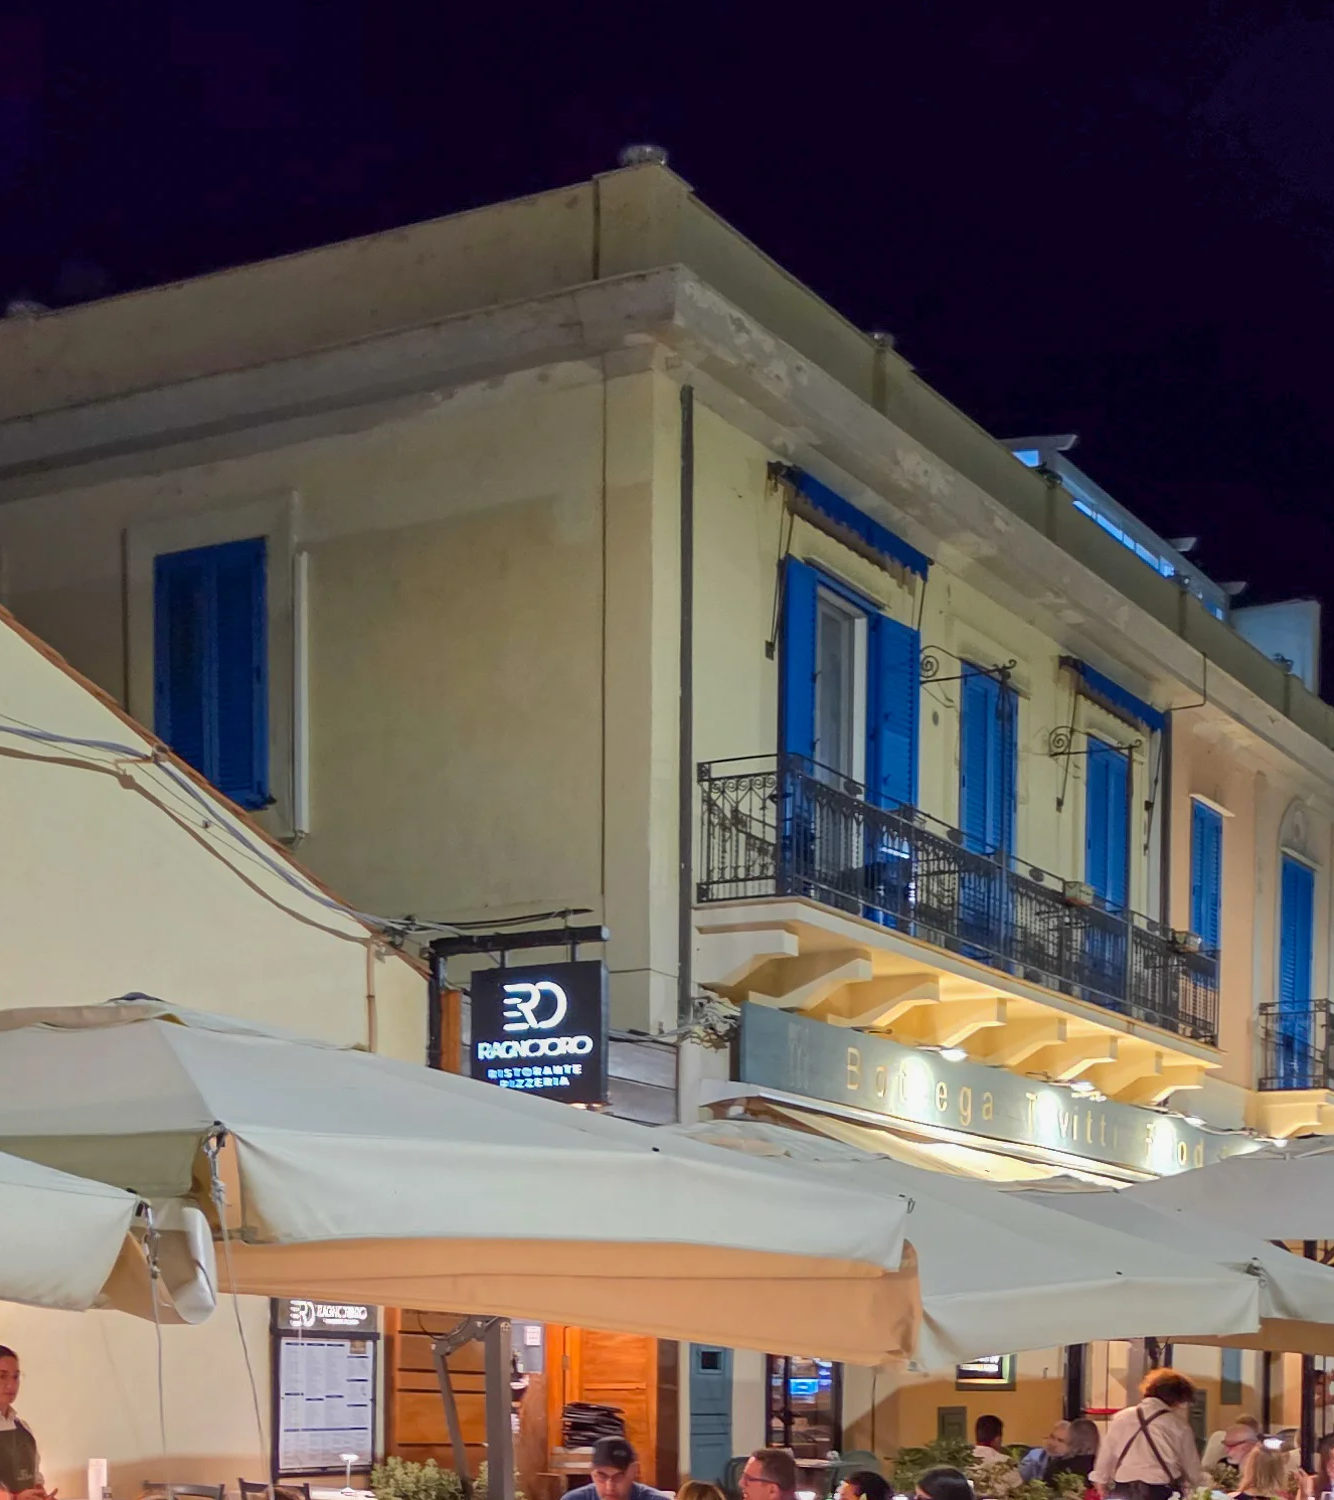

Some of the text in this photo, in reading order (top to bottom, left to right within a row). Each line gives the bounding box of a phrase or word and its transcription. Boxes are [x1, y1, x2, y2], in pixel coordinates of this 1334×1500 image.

[487, 1064, 583, 1079] RISTORANTE
[499, 1076, 570, 1089] PIZZERIA
[847, 1046, 994, 1127] Botega
